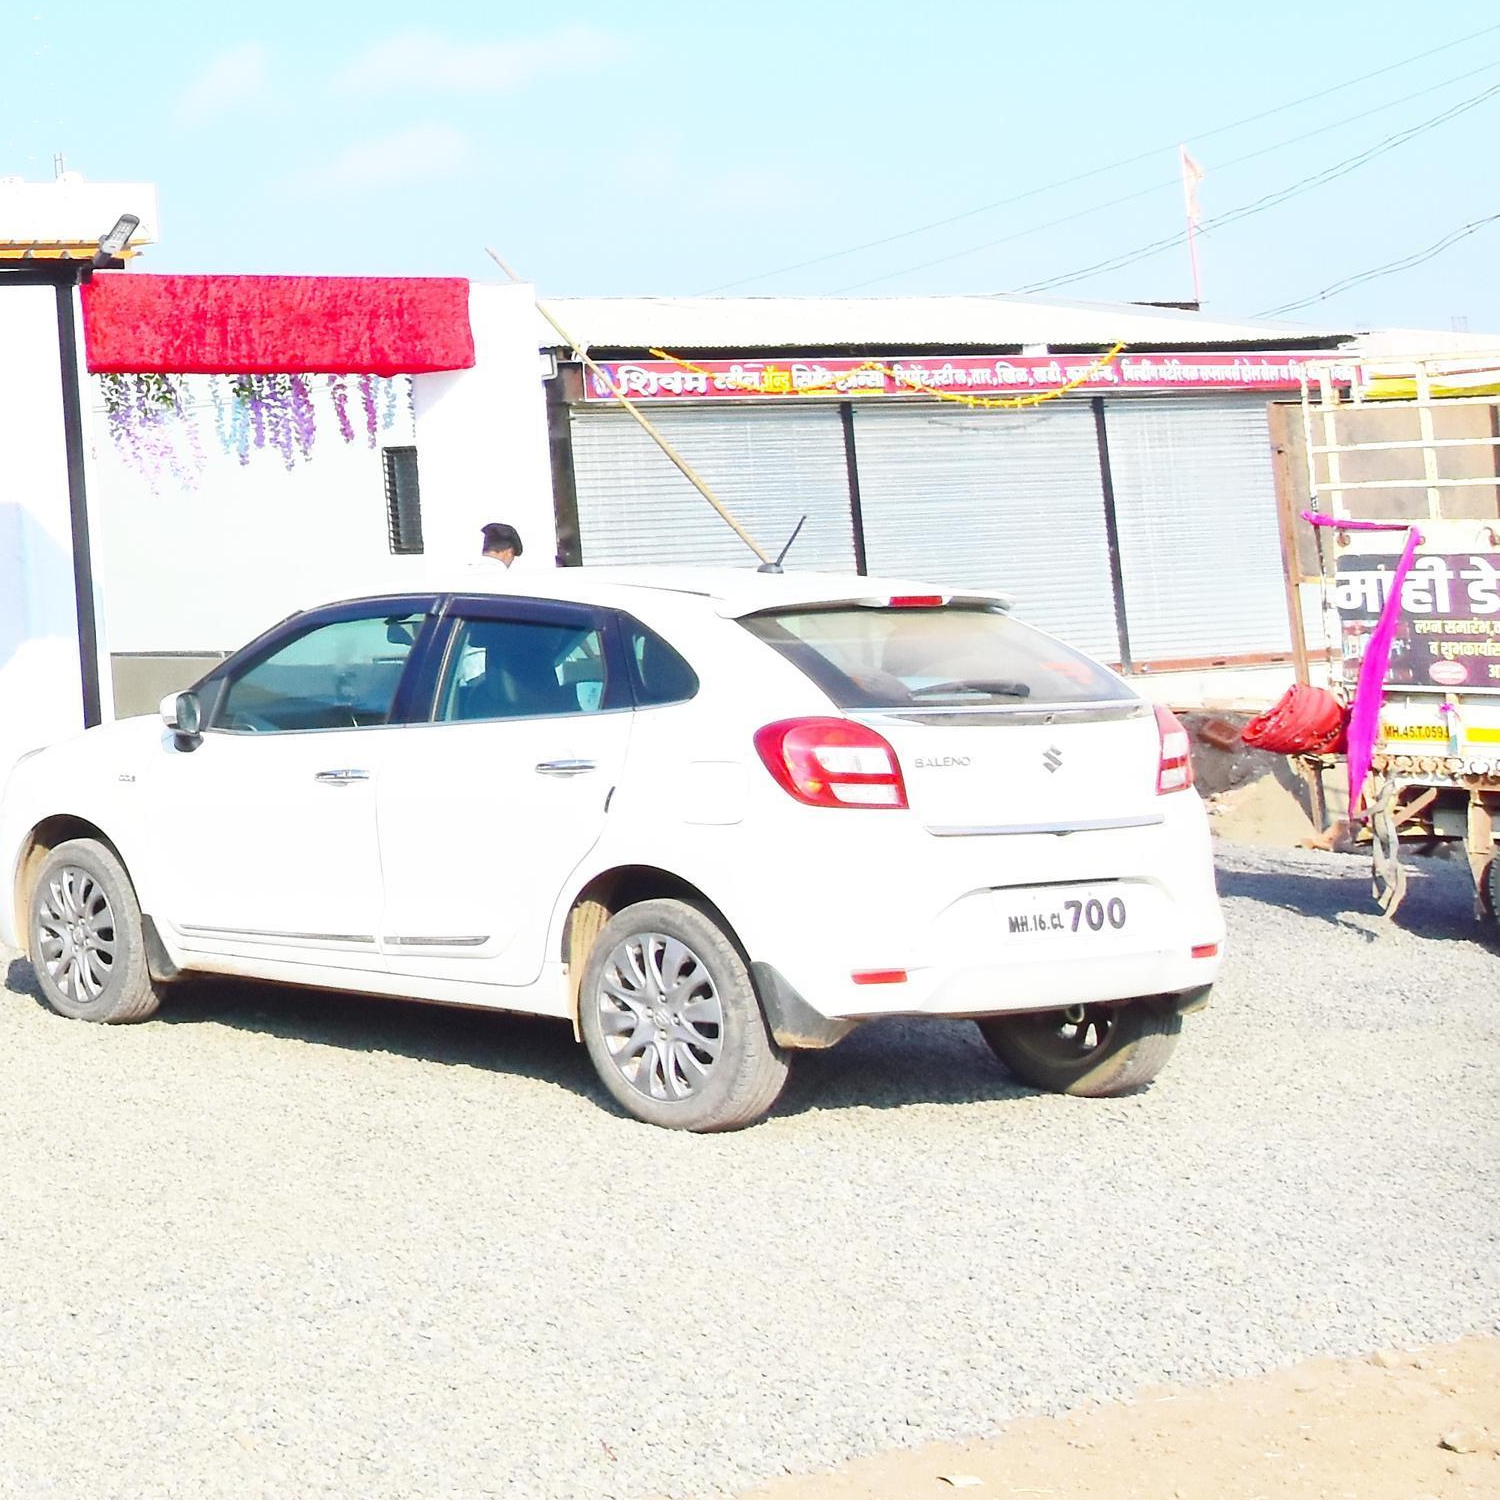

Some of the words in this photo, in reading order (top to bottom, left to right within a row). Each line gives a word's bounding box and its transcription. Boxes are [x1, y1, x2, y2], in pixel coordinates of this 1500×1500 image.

[617, 365, 707, 396] शिवम
[914, 756, 971, 768] BALENO
[1064, 897, 1126, 932] 700
